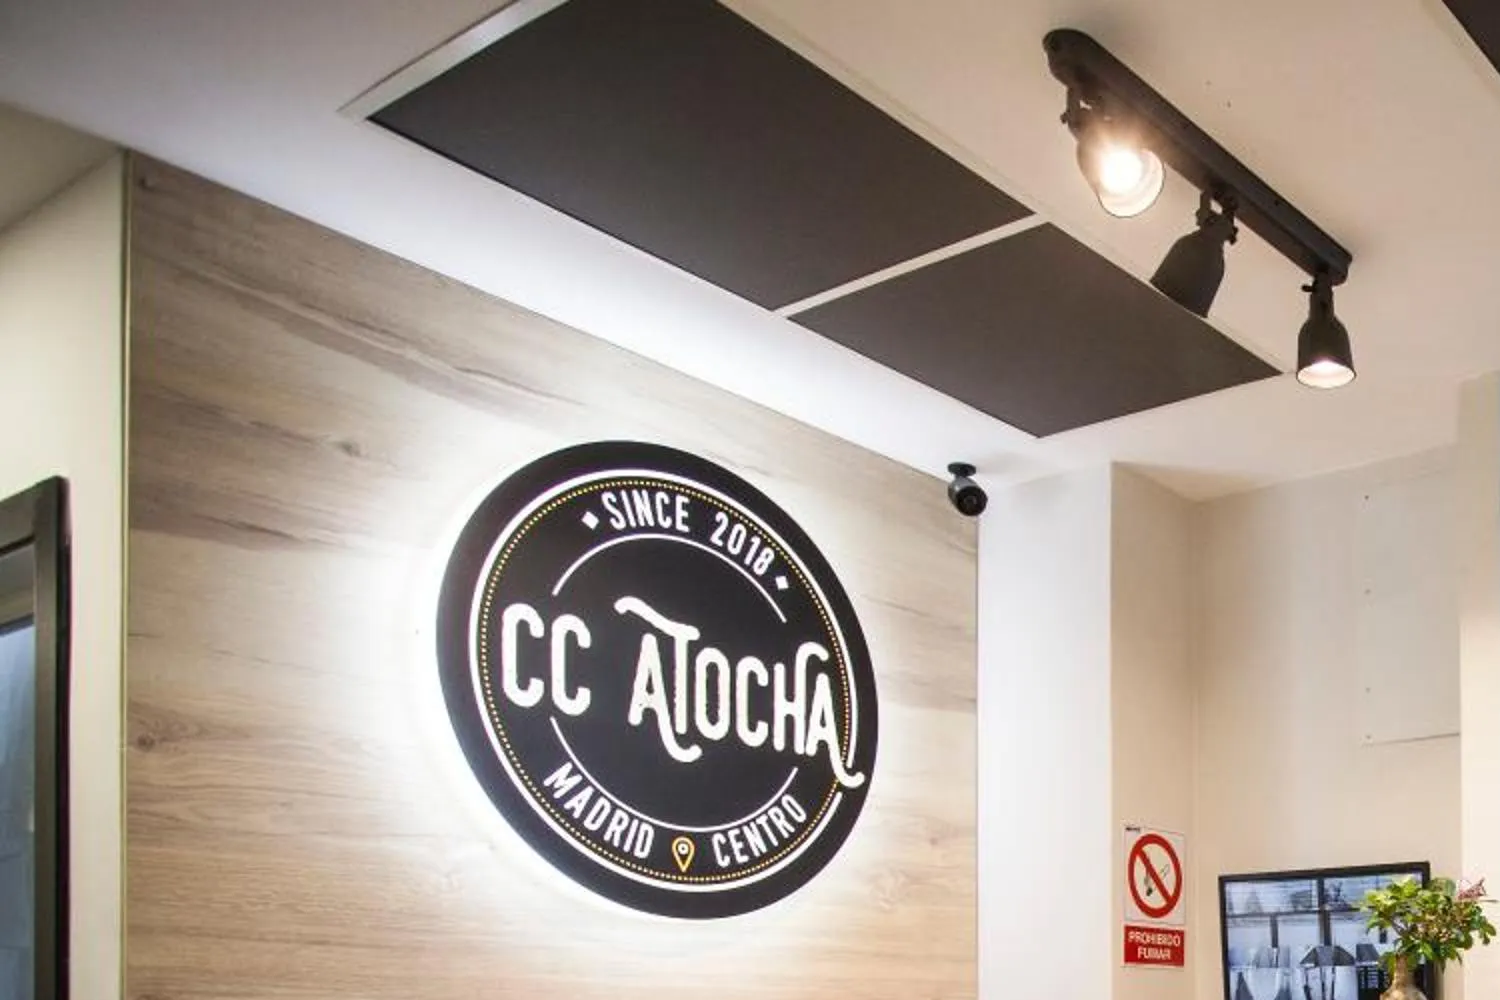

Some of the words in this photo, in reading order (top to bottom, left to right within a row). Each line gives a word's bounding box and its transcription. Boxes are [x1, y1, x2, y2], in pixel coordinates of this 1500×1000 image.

[601, 490, 690, 533] SINCE
[709, 511, 776, 573] 2018
[502, 602, 591, 716] CC
[614, 596, 865, 788] ATOCHA
[543, 762, 656, 860] MADRID
[712, 792, 808, 868] CENTRO
[1127, 931, 1181, 947] PROHIBIDO
[1137, 946, 1171, 960] FUMAR
